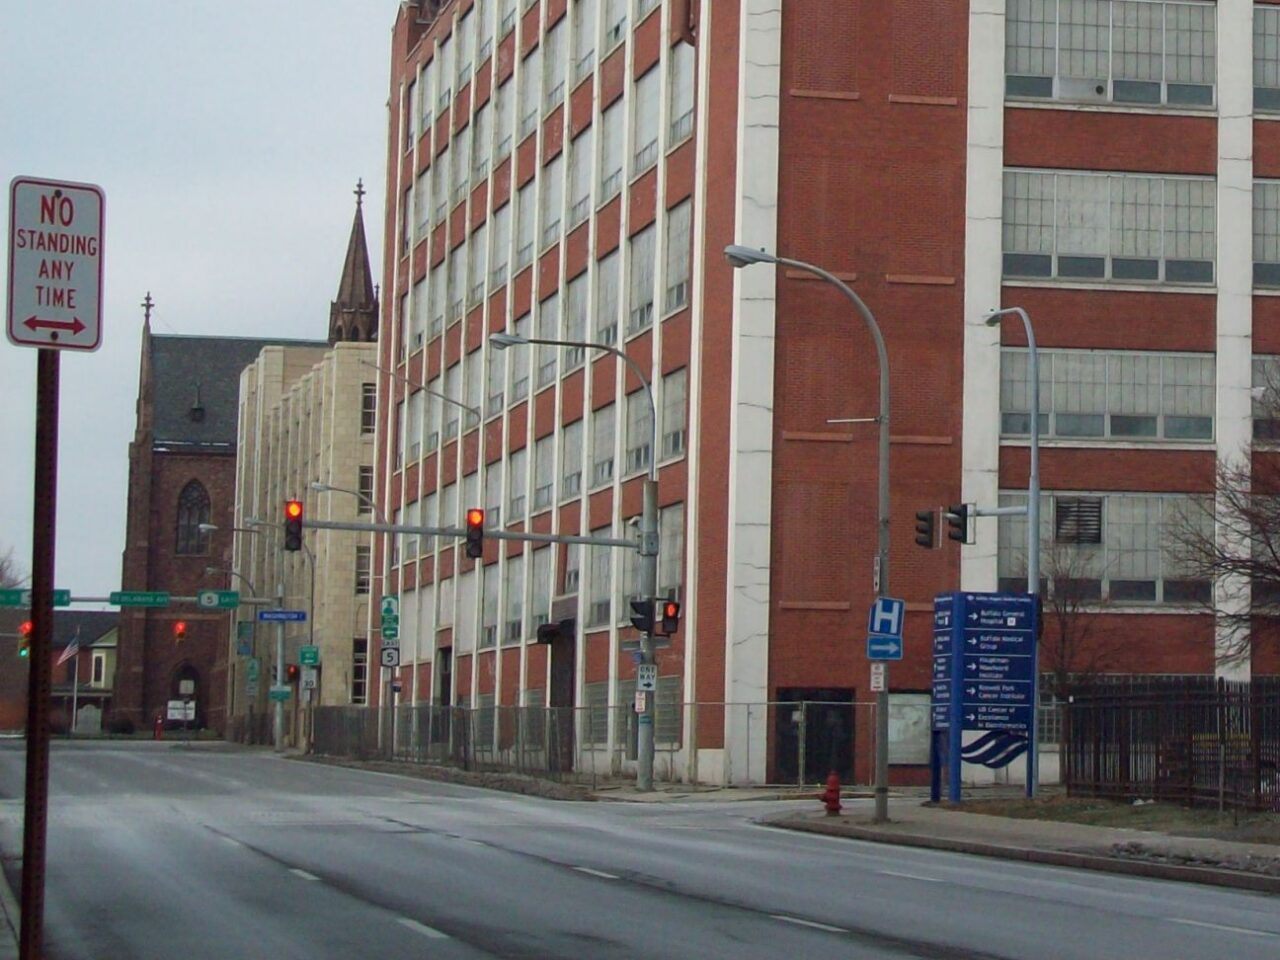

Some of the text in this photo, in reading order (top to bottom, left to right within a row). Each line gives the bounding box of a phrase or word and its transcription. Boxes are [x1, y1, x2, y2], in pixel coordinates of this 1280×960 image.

[40, 194, 74, 227] NO
[17, 228, 97, 256] STANDING
[38, 259, 75, 281] ANY
[36, 285, 77, 309] TIME
[873, 600, 900, 634] H
[387, 652, 394, 663] 5
